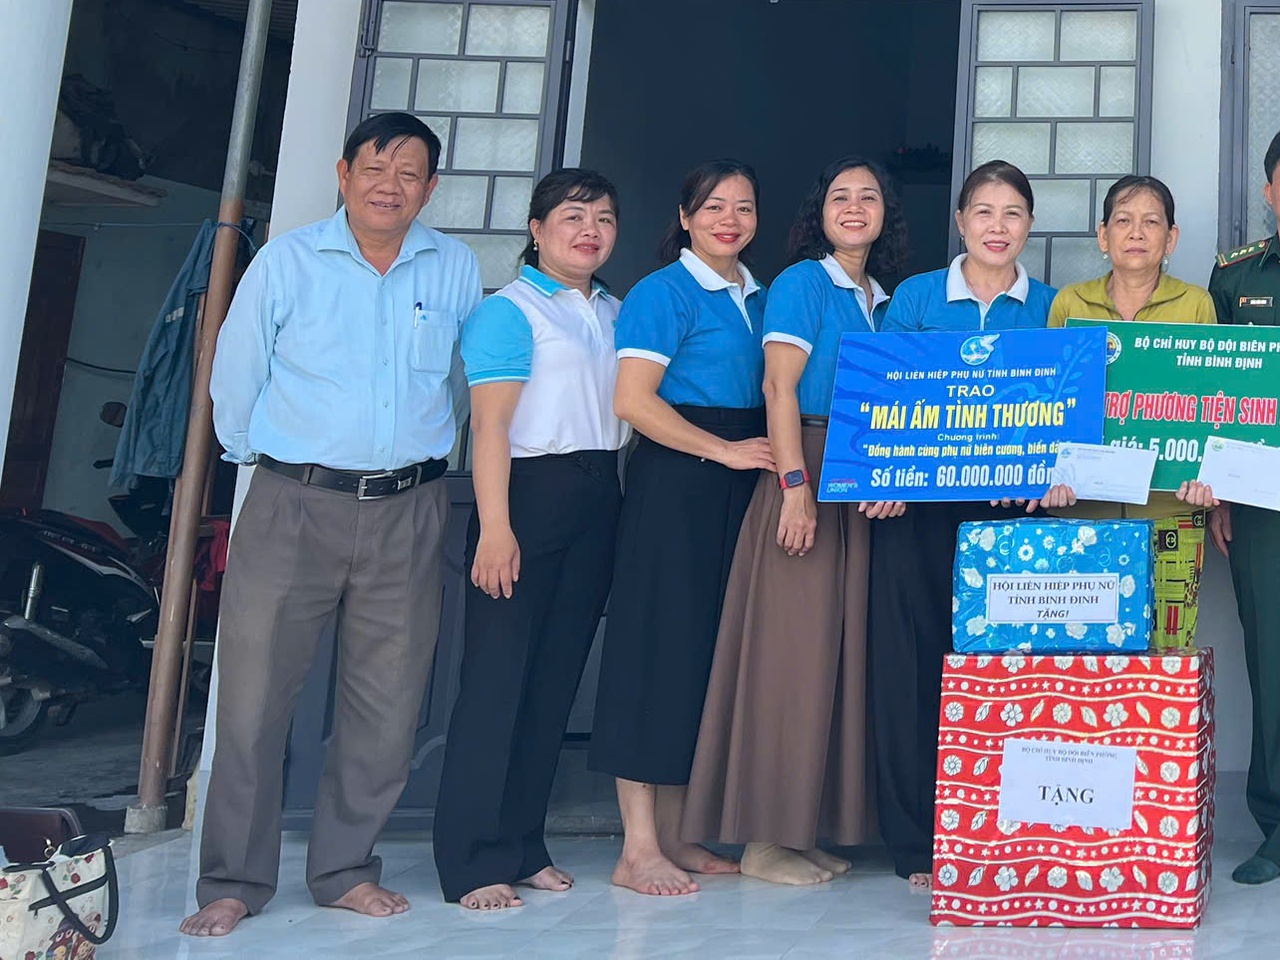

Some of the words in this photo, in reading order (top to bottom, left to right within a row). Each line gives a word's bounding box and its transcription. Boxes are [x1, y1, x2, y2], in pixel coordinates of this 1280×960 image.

[1134, 337, 1149, 350] BỘ
[1153, 336, 1172, 348] CHỈ
[1175, 339, 1197, 350] HUY
[1200, 338, 1214, 352] BỘ
[1218, 339, 1236, 353] ĐỘI
[1240, 339, 1266, 352] BIÊN
[1176, 353, 1202, 366] TỈNH
[1205, 354, 1232, 368] BÌNH
[1235, 357, 1262, 370] ĐỊNH
[887, 370, 902, 381] HỘI
[905, 369, 924, 380] LIÊN
[951, 370, 969, 381] PHỤ
[946, 384, 995, 397] TRAO
[860, 401, 906, 430] “MÁI
[910, 399, 940, 429] ẤM
[946, 400, 987, 428] TÌNH
[992, 398, 1076, 428] THƯƠNG”
[1104, 390, 1132, 425] TRỢ
[1132, 391, 1197, 422] PHƯƠNG
[1201, 390, 1236, 429] TIỆN
[1239, 396, 1277, 425] SINH
[938, 433, 973, 442] Chương
[893, 444, 915, 456] hành
[941, 444, 958, 458] phụ
[974, 443, 993, 456] biên
[1028, 441, 1046, 454] biển
[1149, 438, 1202, 462] 5.000.
[870, 466, 893, 487] Số
[895, 465, 929, 487] tiền:
[936, 464, 1023, 487] 60.000.000
[1028, 460, 1052, 485] đồn
[994, 581, 1013, 591] HỘI
[1017, 581, 1040, 590] LIÊN
[1072, 582, 1095, 591] PHỤ
[1038, 608, 1069, 620] TẶNG!
[1038, 784, 1094, 806] TẶNG
